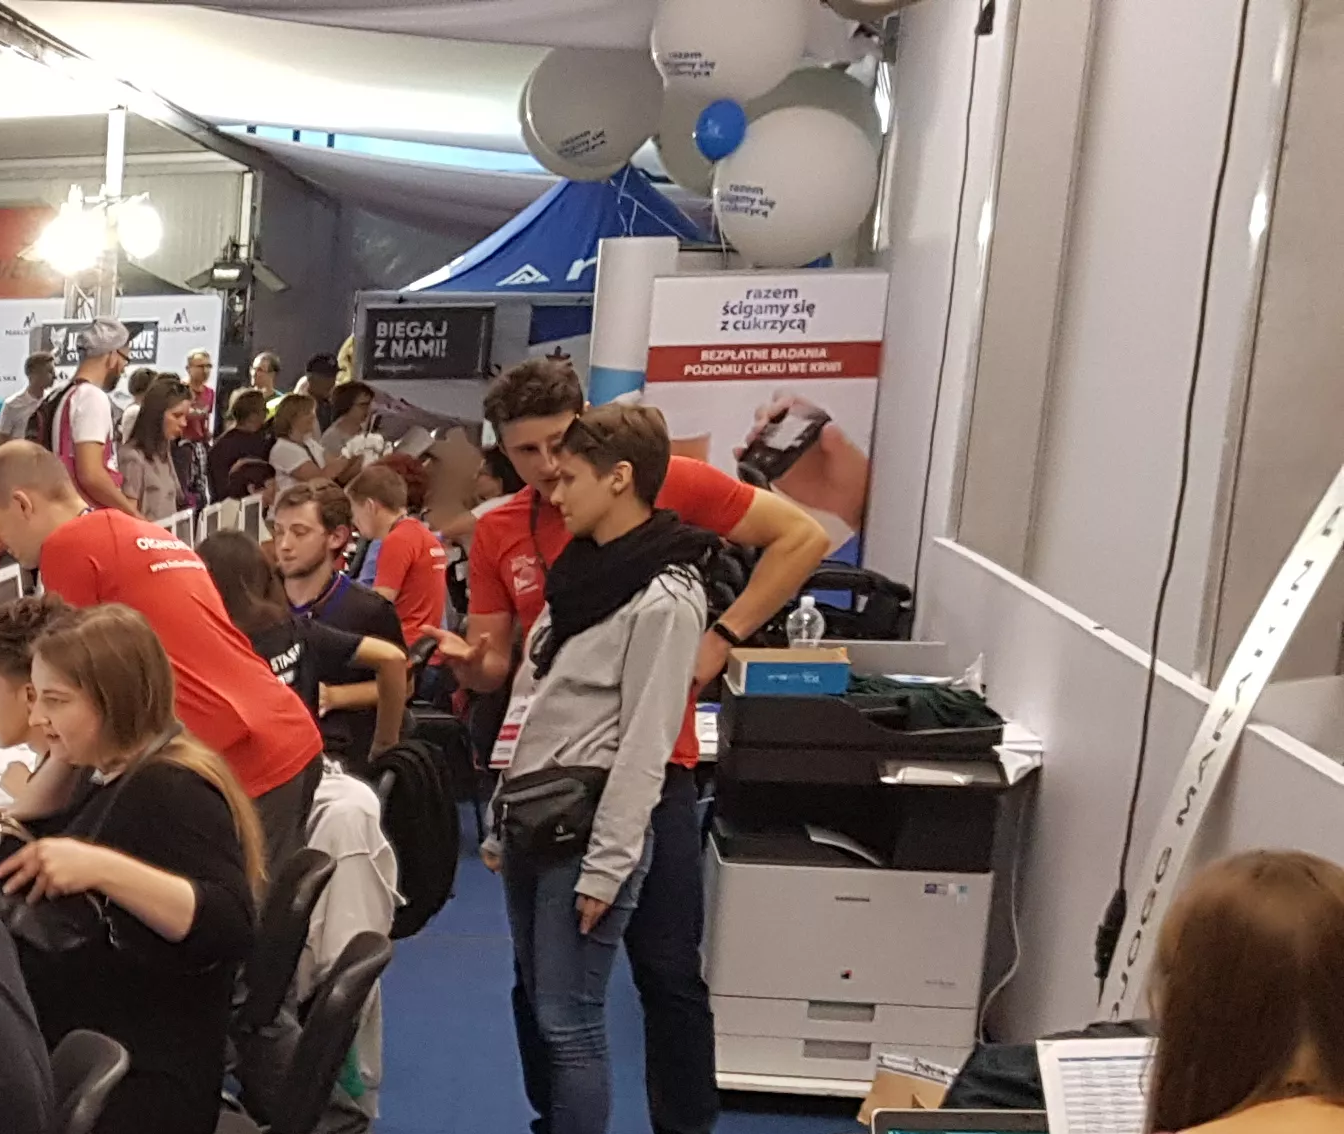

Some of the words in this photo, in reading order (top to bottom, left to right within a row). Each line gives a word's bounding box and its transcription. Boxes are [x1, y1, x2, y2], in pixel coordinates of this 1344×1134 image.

[746, 288, 799, 300] razem
[722, 301, 790, 319] ścigamy
[793, 299, 816, 318] się
[376, 320, 449, 338] BIEGAJ
[720, 319, 729, 331] z
[732, 317, 807, 334] cukrzycą
[374, 340, 386, 358] Z
[390, 339, 448, 358] NAMI!
[700, 348, 769, 362] BEZPŁATNE
[683, 362, 743, 376] POZIOMU
[744, 361, 786, 375] CUKRU
[788, 361, 807, 373] WE
